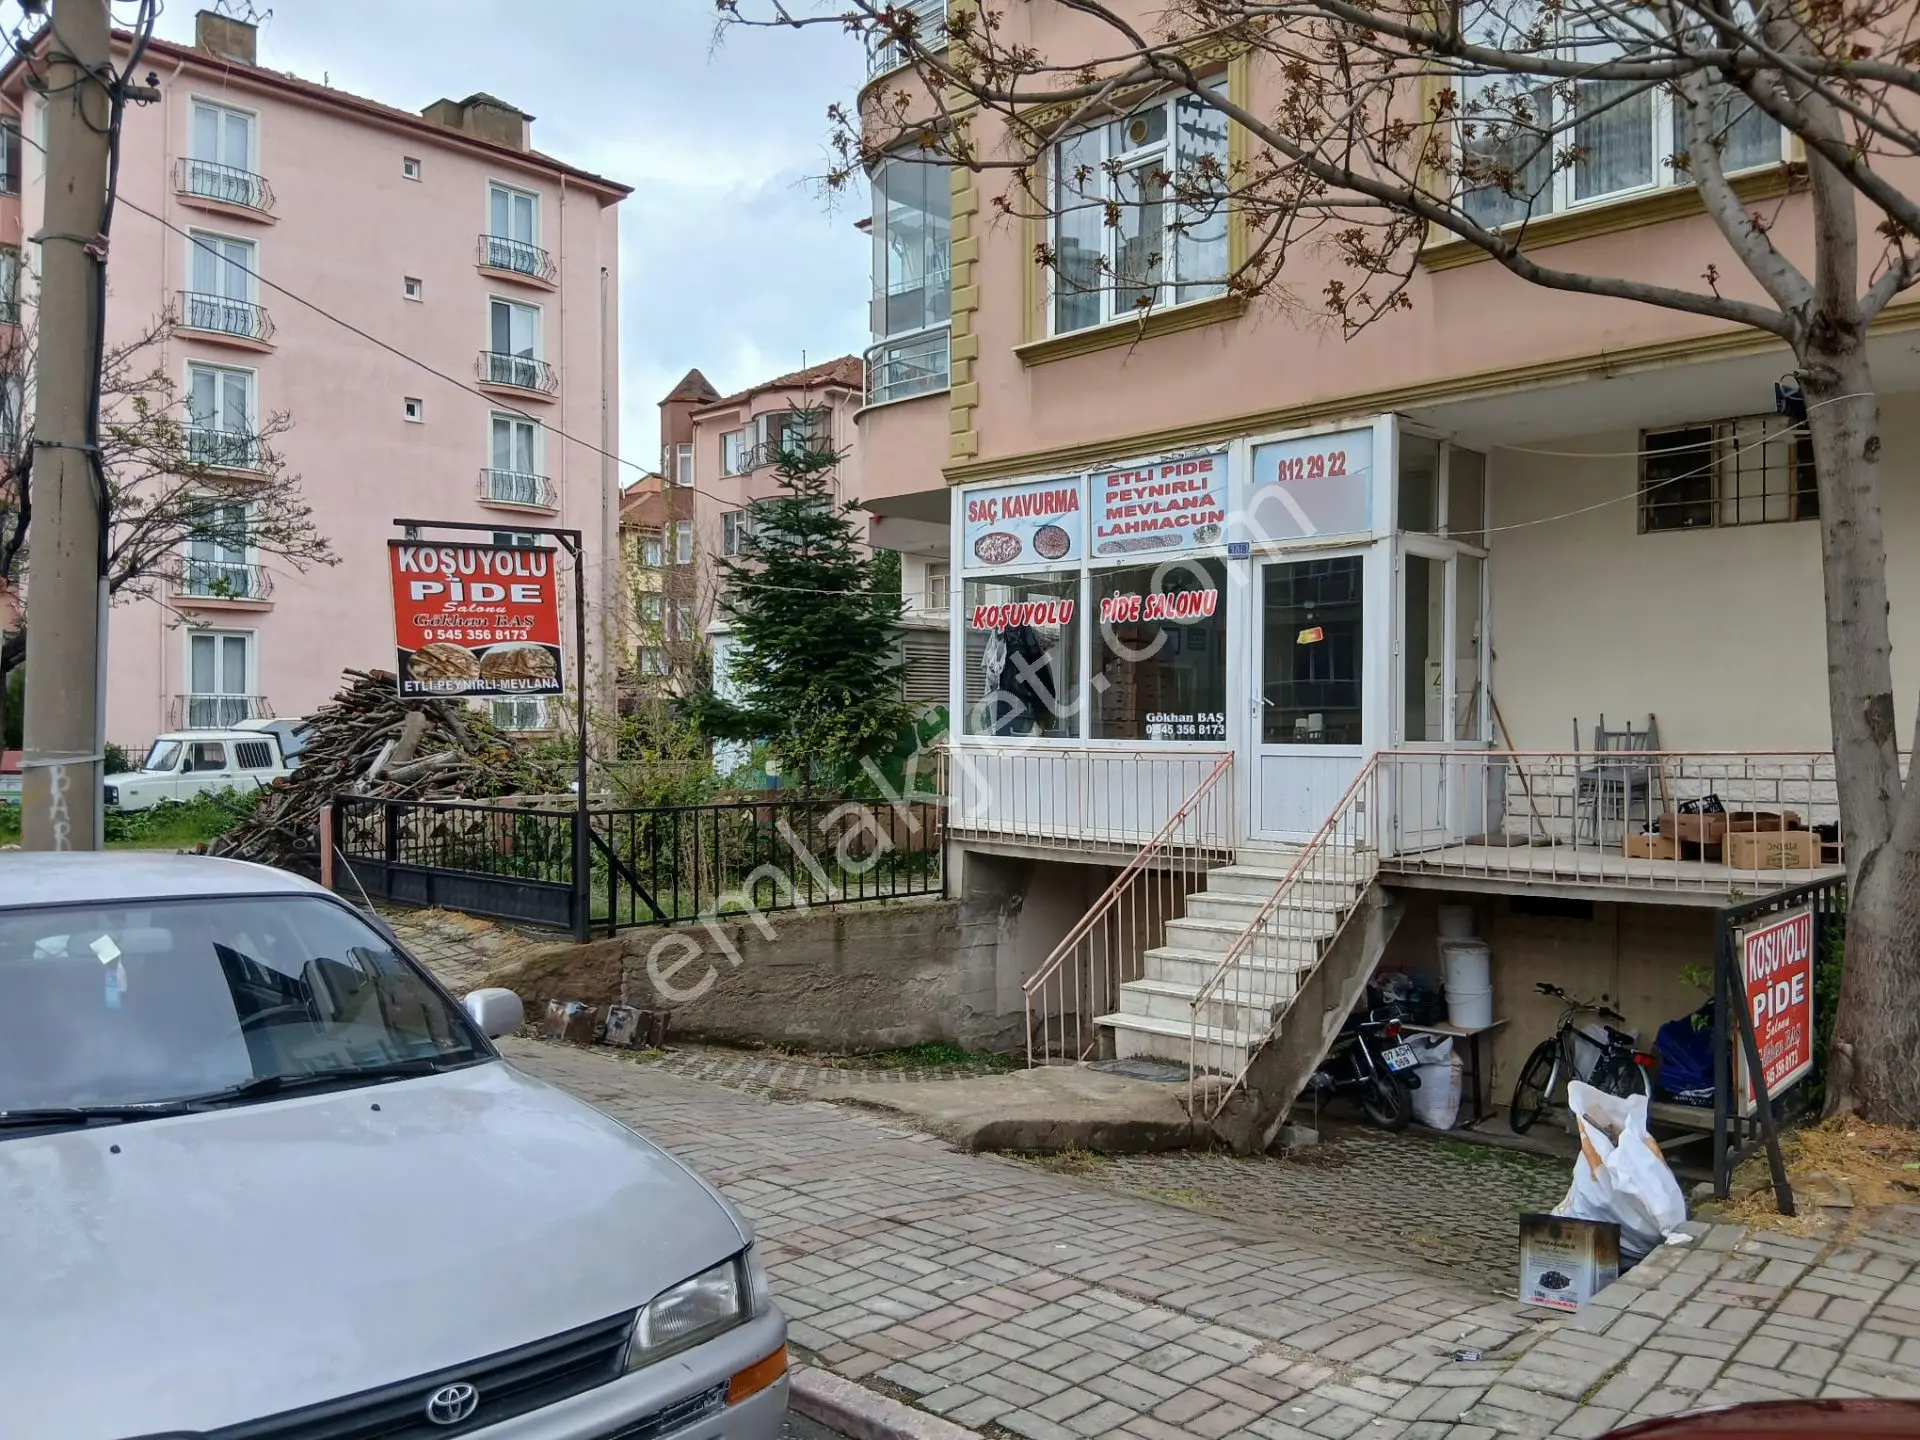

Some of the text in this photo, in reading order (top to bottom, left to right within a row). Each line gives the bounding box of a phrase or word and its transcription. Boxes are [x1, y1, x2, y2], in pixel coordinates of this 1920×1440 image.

[1278, 450, 1346, 482] 812 29 22
[968, 487, 1080, 526] SAÇ KAVURMA
[1105, 493, 1216, 521] MEVLANA
[1097, 509, 1225, 538] LAHMACUN
[399, 547, 548, 579] KOŞUYOLU
[410, 577, 543, 603] PİDE
[412, 613, 535, 630] Gökhan BAŞ
[441, 602, 508, 613] Salonu
[972, 589, 1219, 633] KOŞUYOLU PİDE SALONU
[424, 630, 528, 640] 0 545 356 8173
[1146, 712, 1225, 725] Gökhan BAŞ
[1176, 724, 1196, 735] 356
[1198, 724, 1225, 735] 8173
[1749, 918, 1809, 984] KOŞUYOLU
[1753, 972, 1805, 1028] PİDE
[1383, 1051, 1394, 1061] 07
